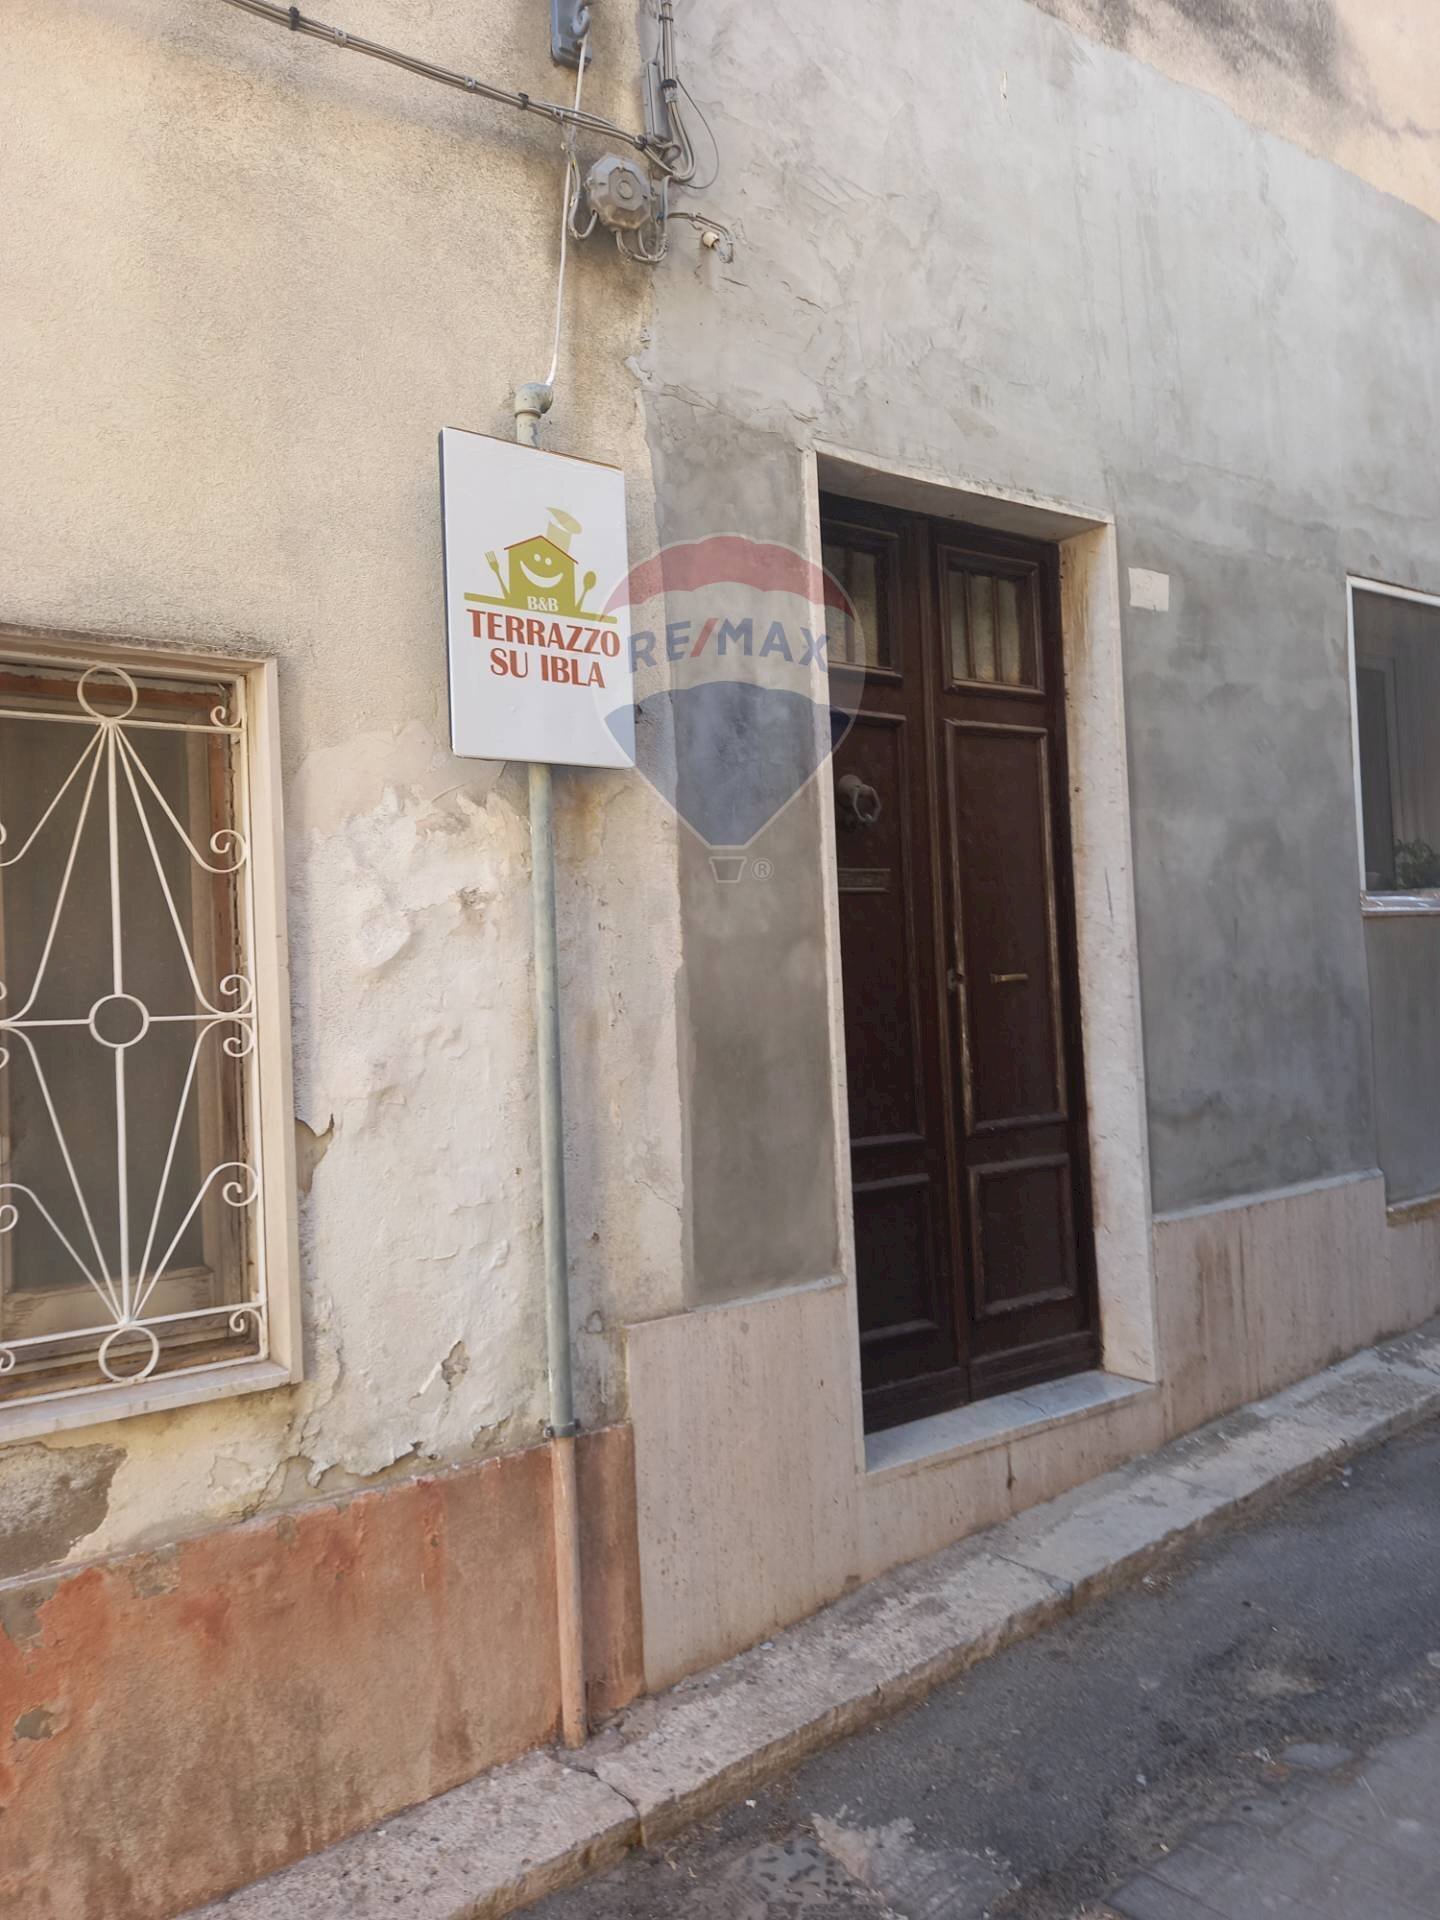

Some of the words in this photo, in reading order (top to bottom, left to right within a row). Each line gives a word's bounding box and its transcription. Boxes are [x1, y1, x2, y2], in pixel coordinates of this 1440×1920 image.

[527, 596, 559, 612] B&B
[466, 608, 620, 657] TERRAZZO
[490, 648, 528, 678] SU
[540, 654, 606, 688] IBLA
